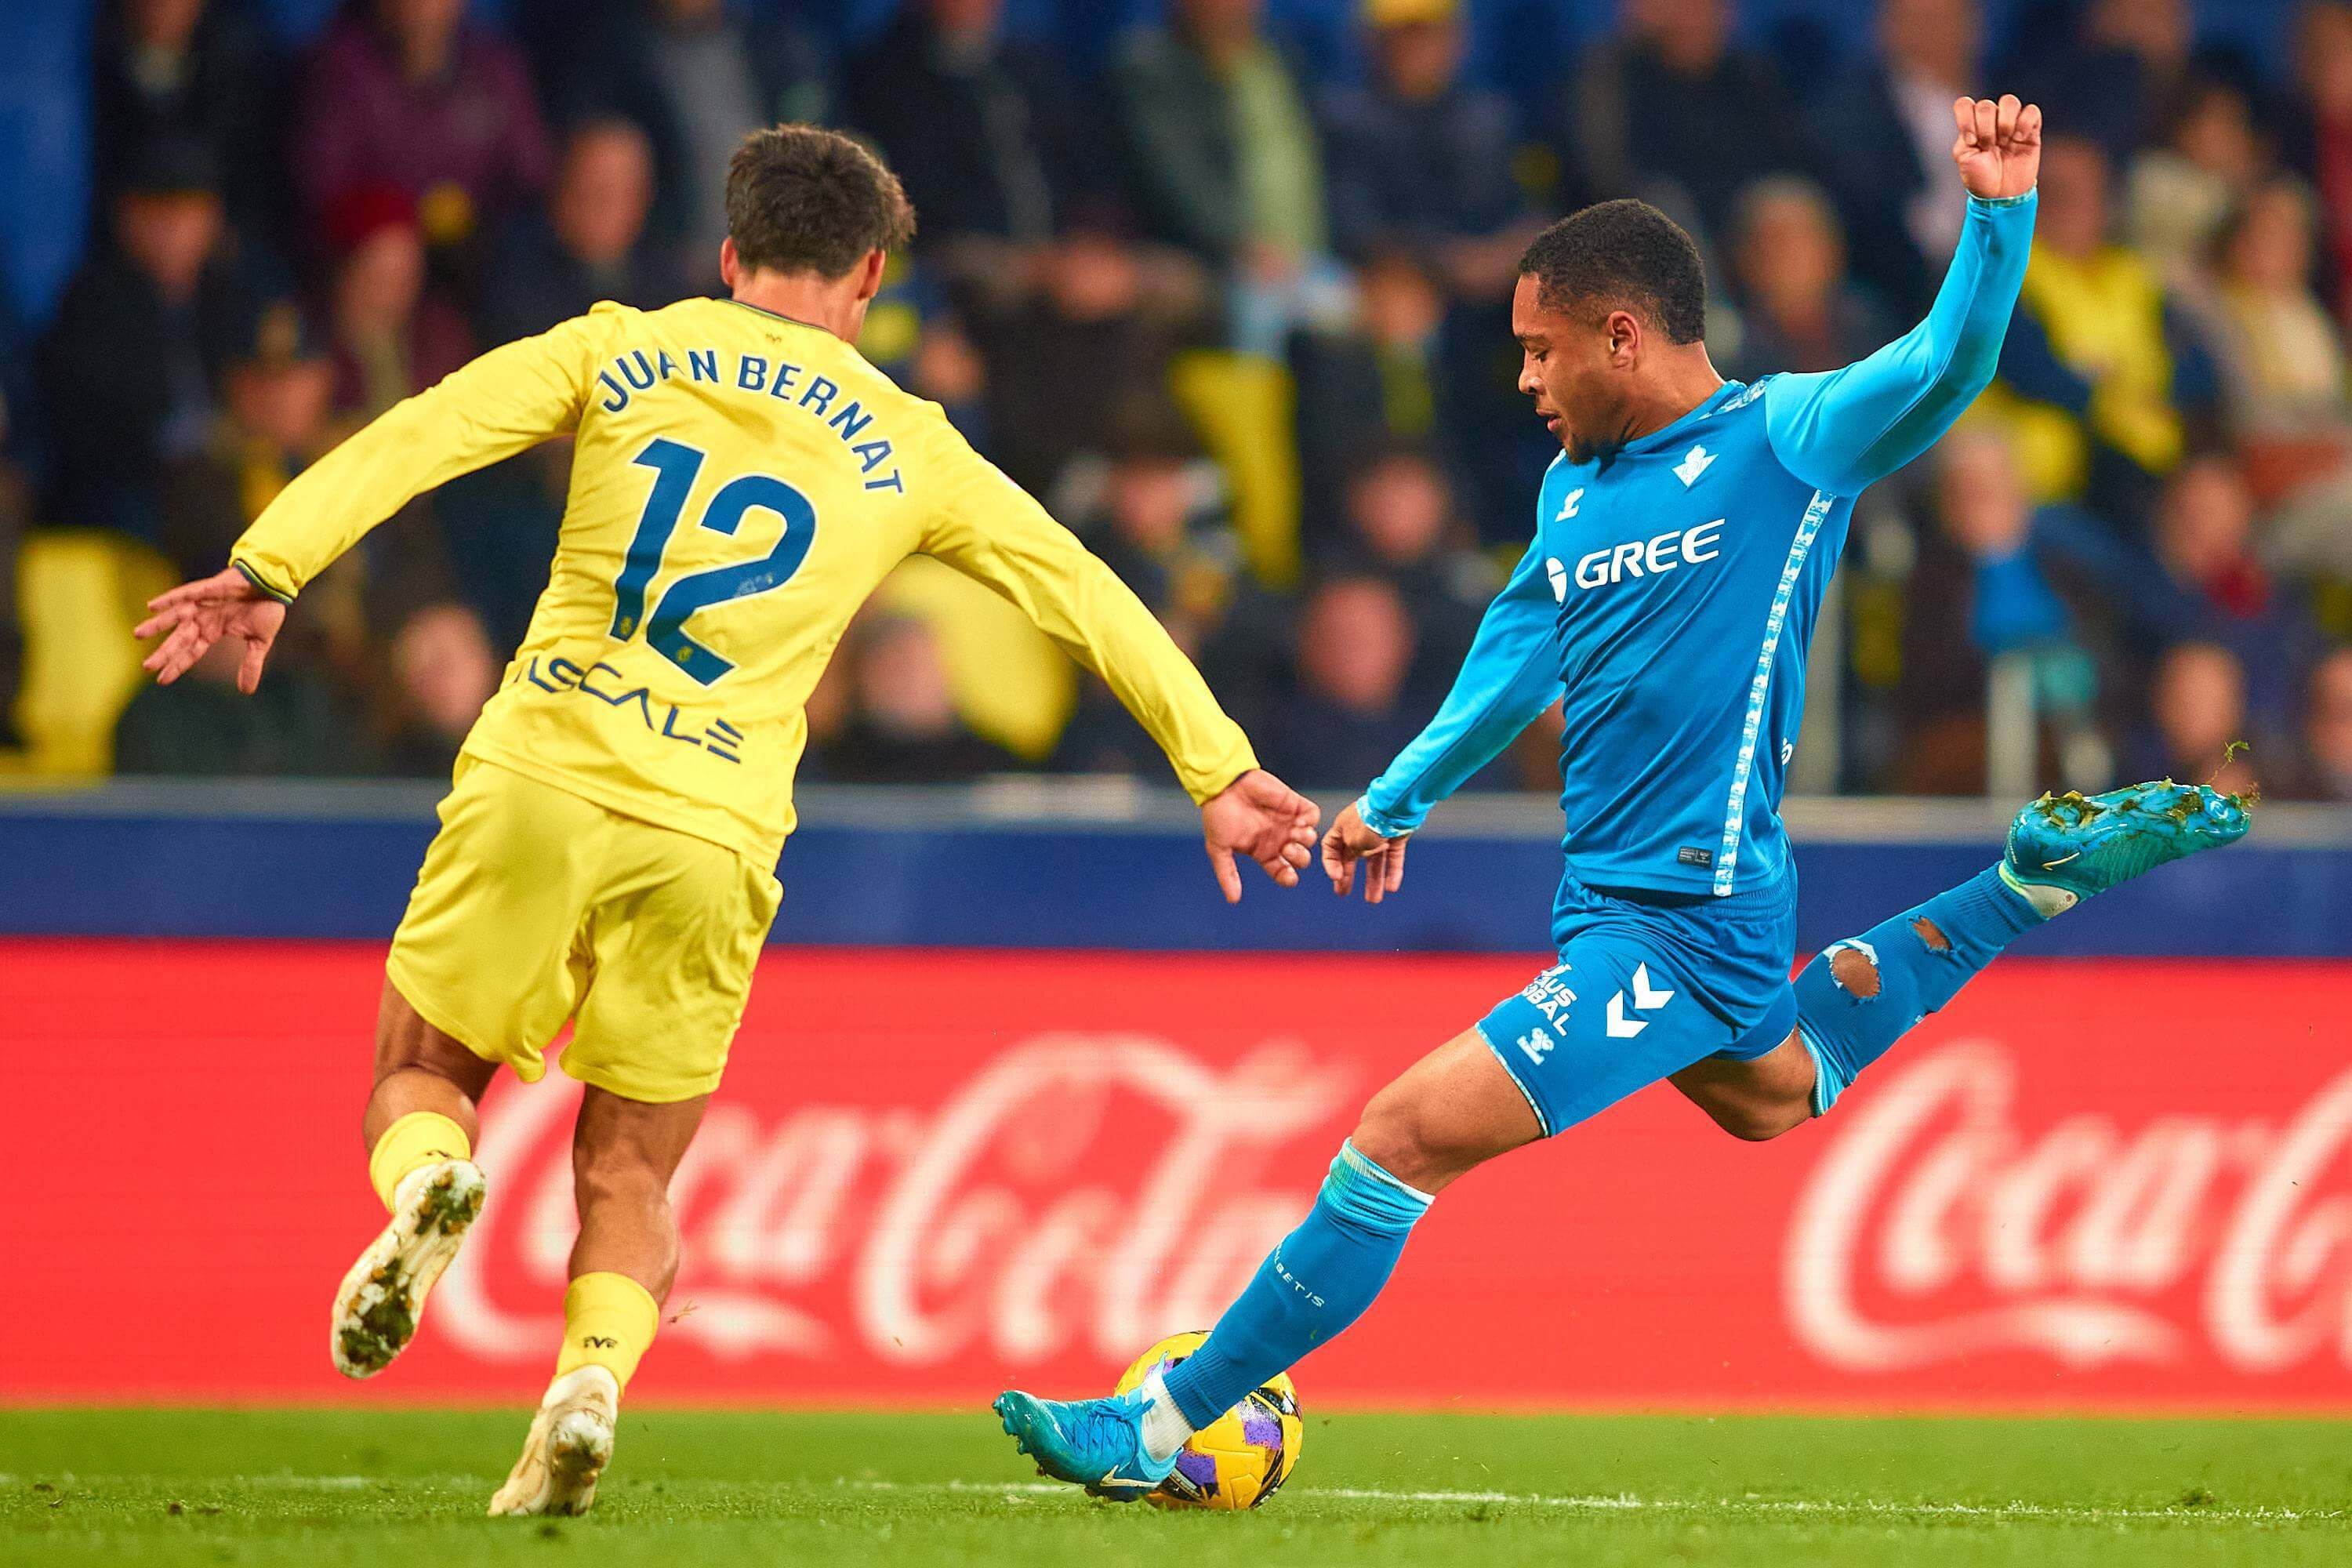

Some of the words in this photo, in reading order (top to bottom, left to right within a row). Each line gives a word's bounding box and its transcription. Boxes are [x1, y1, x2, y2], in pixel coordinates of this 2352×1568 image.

[598, 348, 719, 413] JUAN
[737, 355, 904, 495] BERNAT
[608, 437, 818, 687] 12
[1575, 518, 1726, 590] GREE
